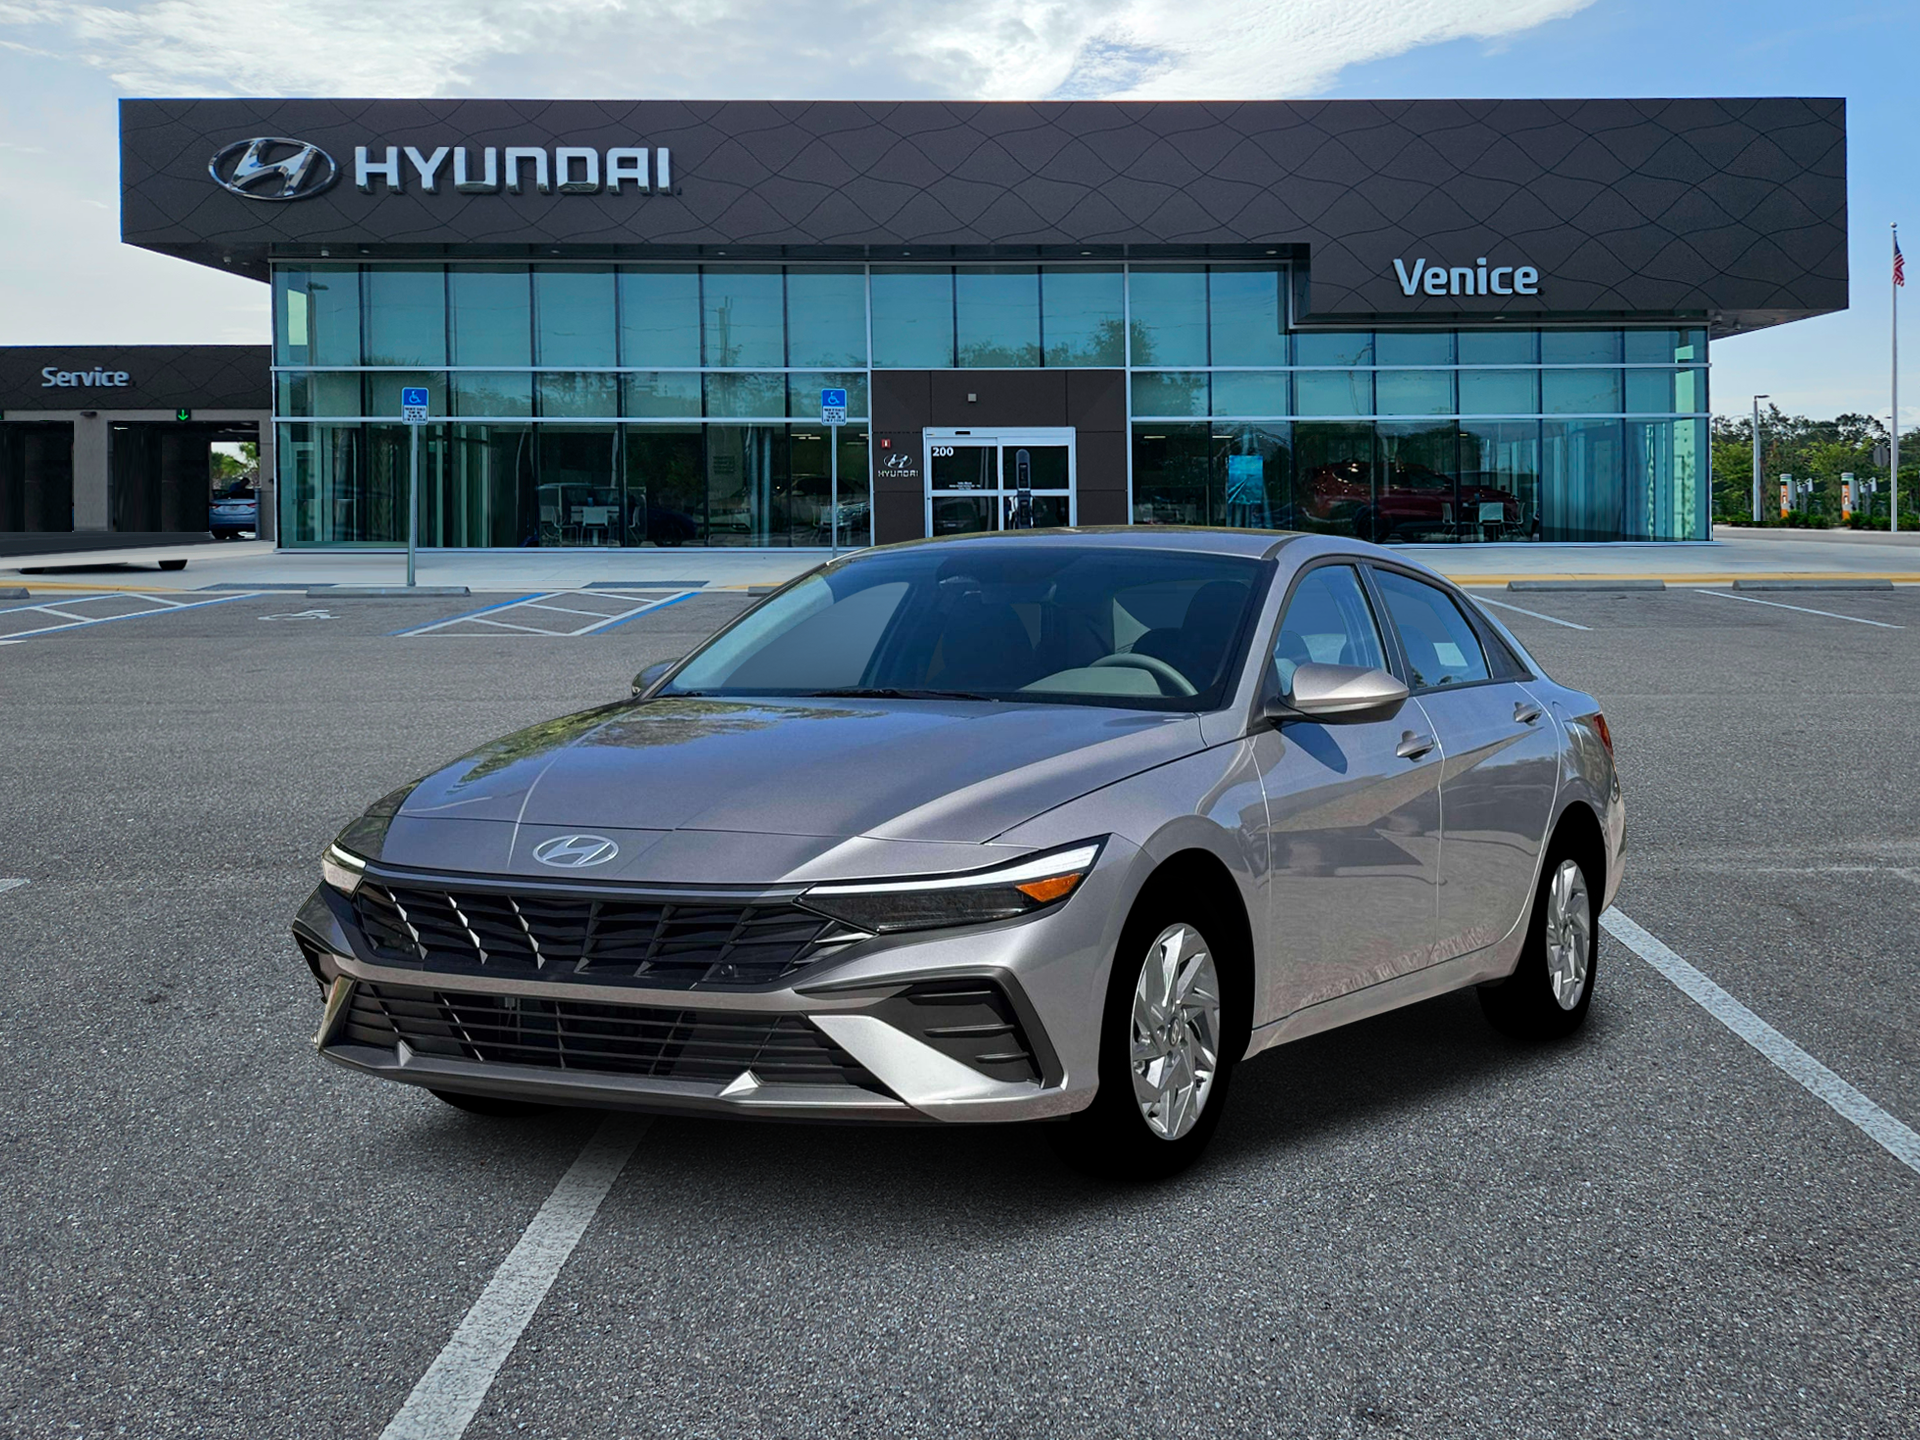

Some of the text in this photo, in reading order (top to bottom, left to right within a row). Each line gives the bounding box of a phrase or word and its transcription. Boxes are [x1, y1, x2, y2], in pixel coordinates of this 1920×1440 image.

[353, 146, 671, 194] HYUNDAI
[1392, 257, 1539, 296] Venice
[41, 366, 130, 387] Service
[932, 446, 954, 457] 200
[877, 469, 920, 478] HYUNDAI
